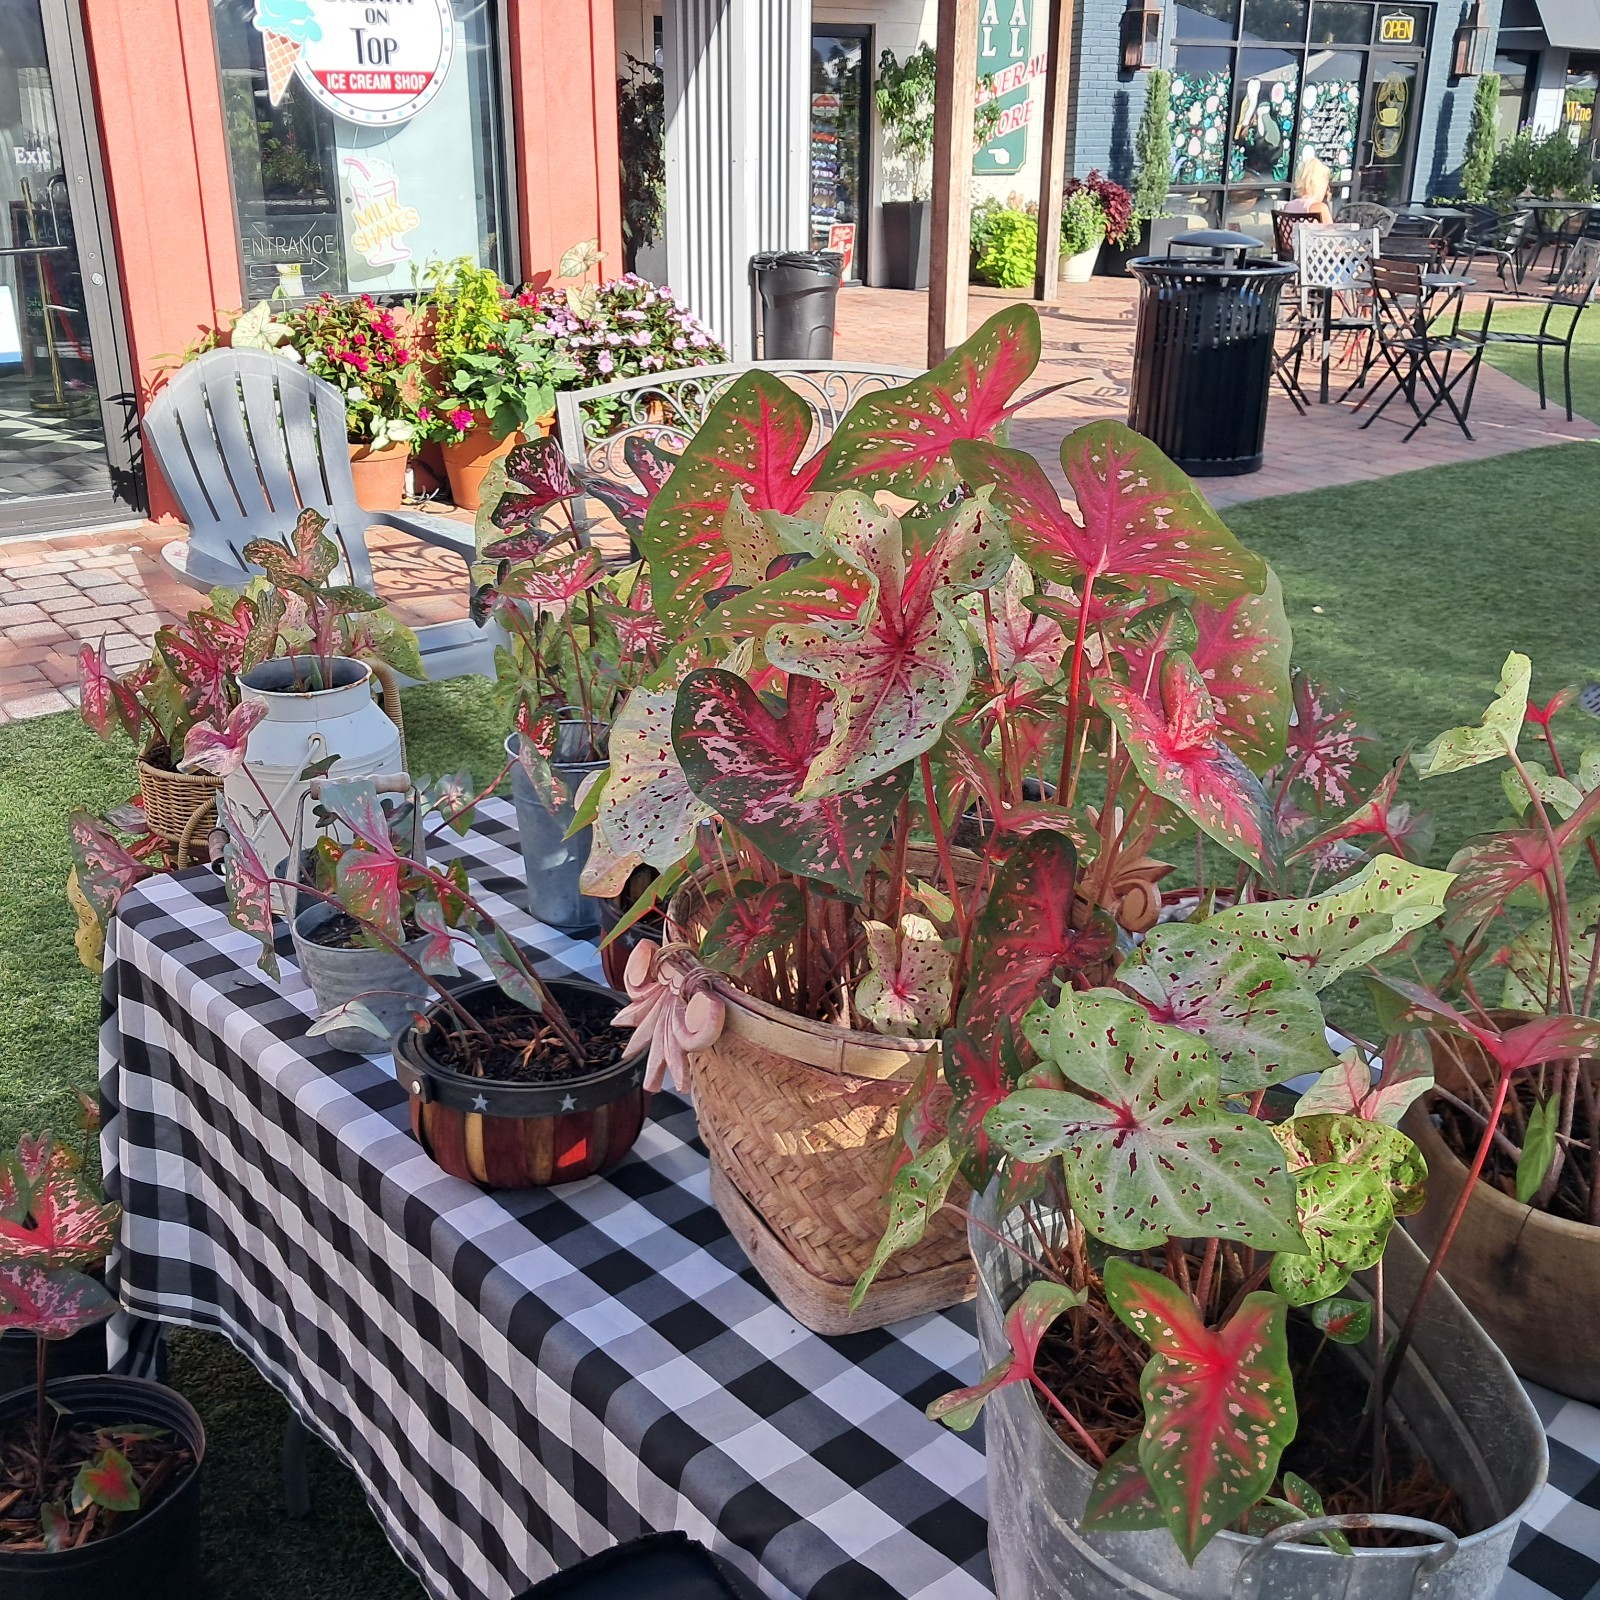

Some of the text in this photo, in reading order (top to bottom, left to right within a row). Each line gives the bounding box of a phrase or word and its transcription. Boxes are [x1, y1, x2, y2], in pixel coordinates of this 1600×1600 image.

[365, 8, 390, 25] ON
[1383, 20, 1412, 39] OPEN
[327, 73, 427, 90] ICE CREAM SHOP
[1566, 101, 1592, 121] Wine
[13, 147, 51, 164] Exit
[353, 196, 401, 230] MILK
[353, 209, 419, 253] SHAKES
[241, 235, 335, 257] ENTRANCE
